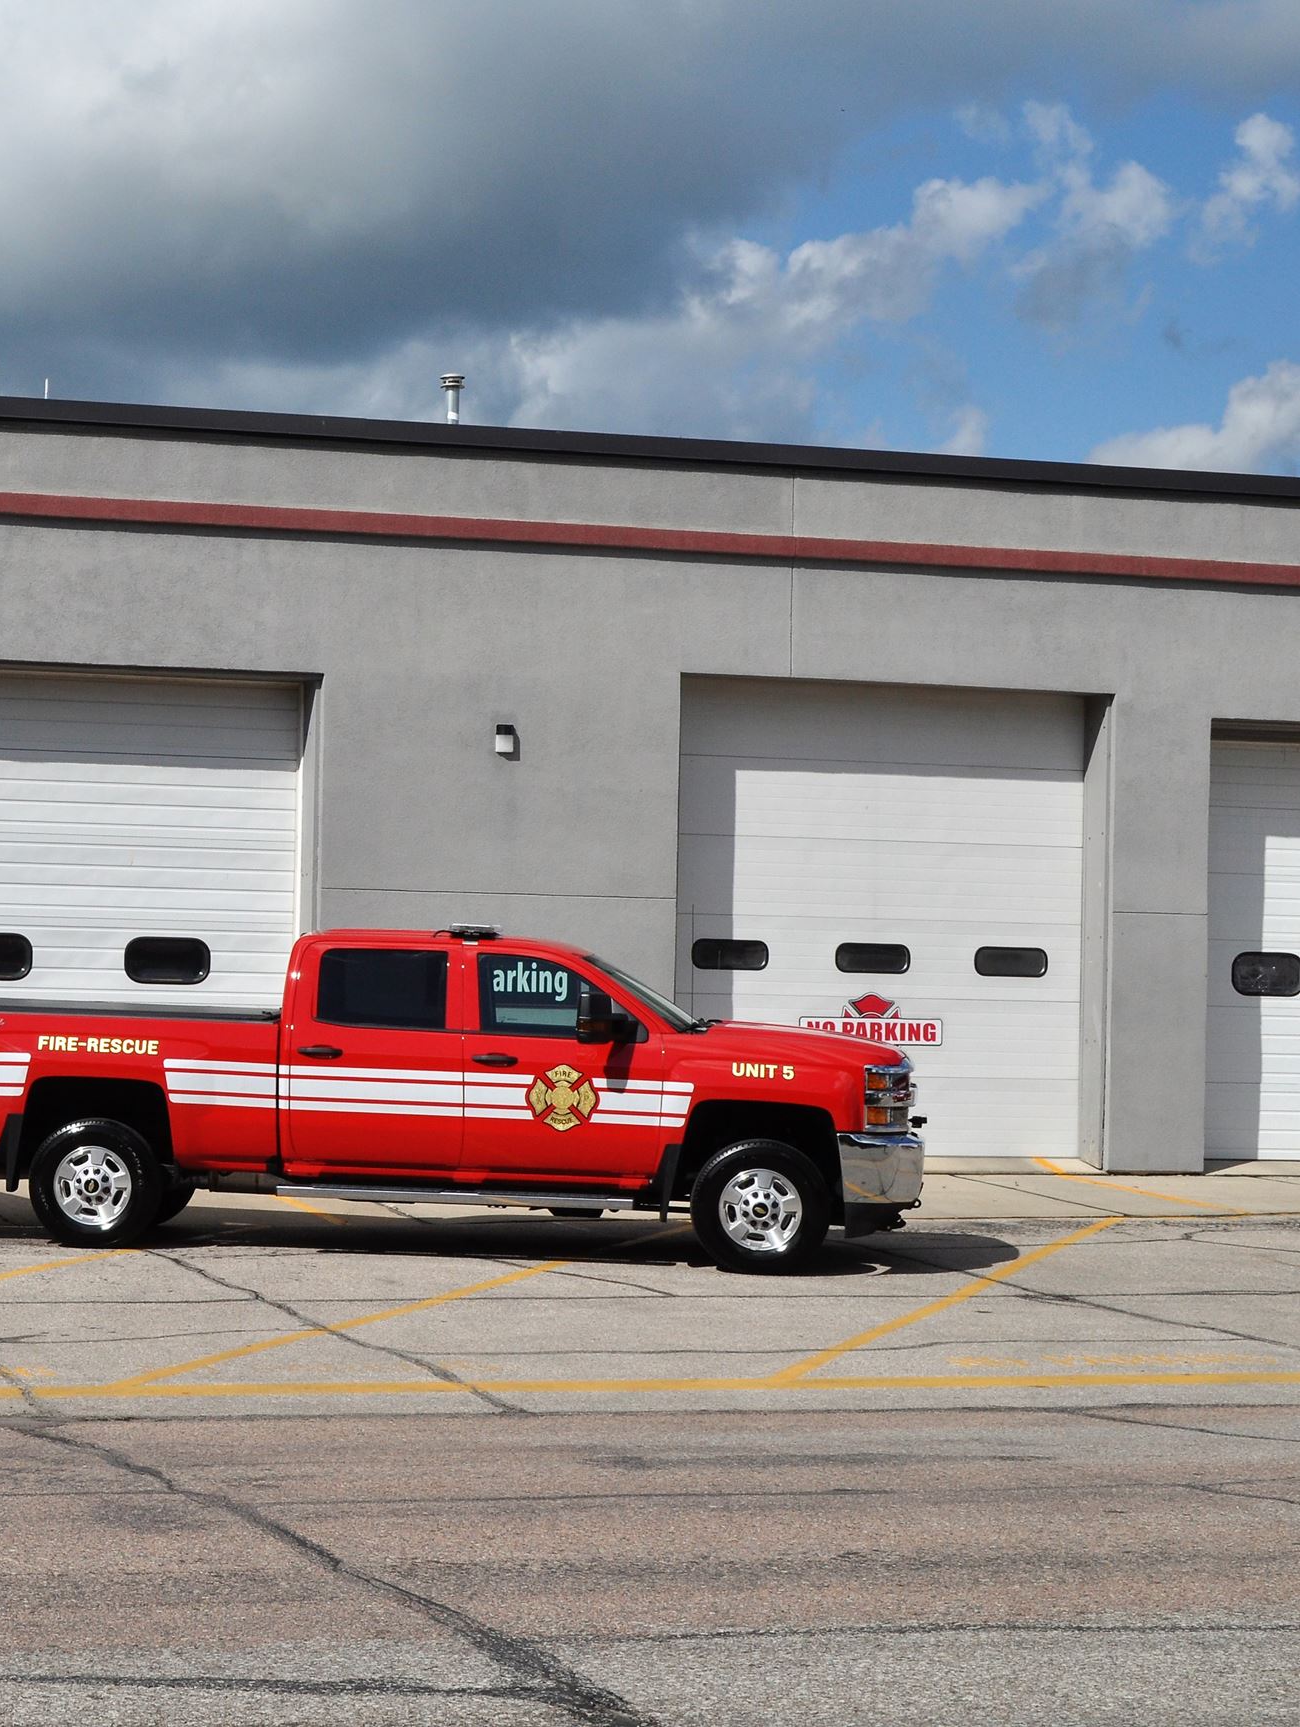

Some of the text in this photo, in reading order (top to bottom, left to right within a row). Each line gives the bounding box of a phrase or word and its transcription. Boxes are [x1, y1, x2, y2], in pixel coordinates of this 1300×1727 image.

[492, 961, 569, 1002] arking
[841, 1021, 937, 1042] PARKING
[37, 1035, 159, 1055] FIRE-RESCUE
[554, 1070, 572, 1078] FIRE
[731, 1062, 795, 1080] UNIT 5
